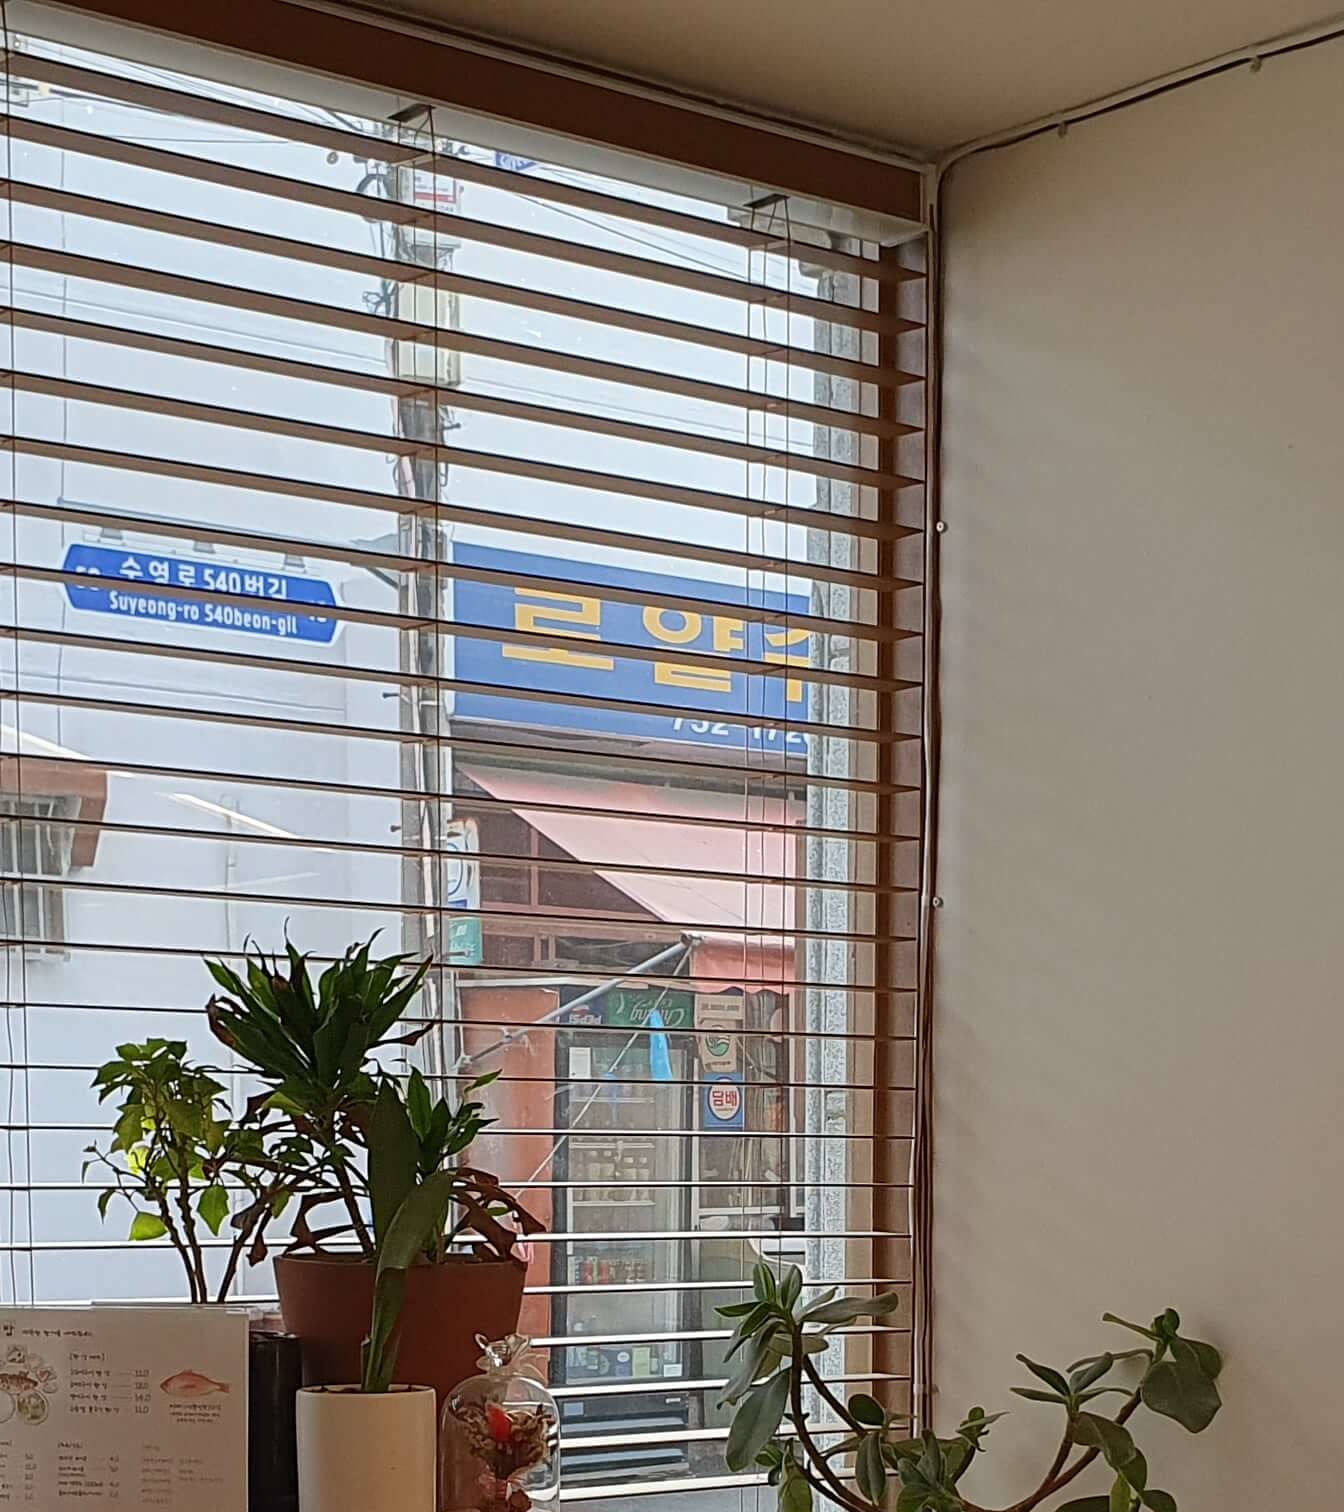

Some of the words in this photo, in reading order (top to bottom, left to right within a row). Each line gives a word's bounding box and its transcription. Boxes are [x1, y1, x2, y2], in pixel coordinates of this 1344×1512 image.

[109, 590, 200, 620] Suyeong-ro
[204, 604, 298, 636] 540beon-gil
[711, 1090, 738, 1107] 담배
